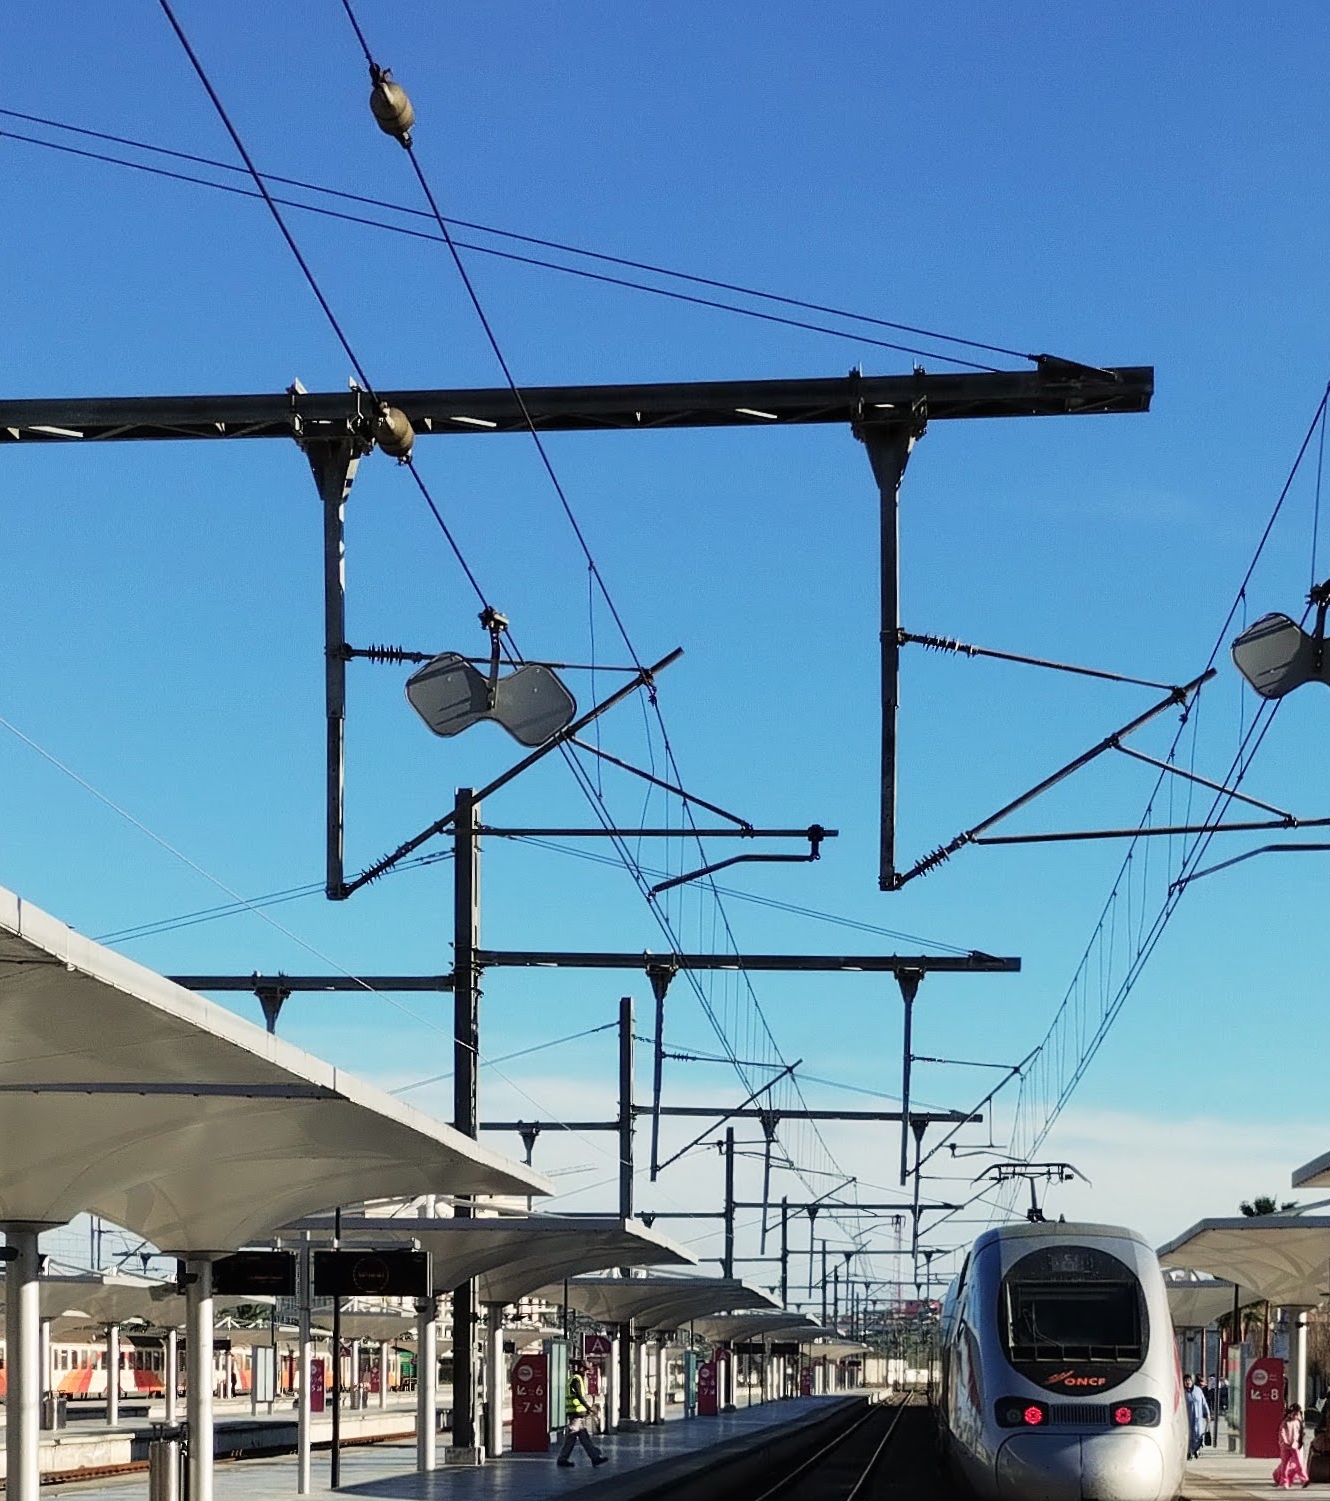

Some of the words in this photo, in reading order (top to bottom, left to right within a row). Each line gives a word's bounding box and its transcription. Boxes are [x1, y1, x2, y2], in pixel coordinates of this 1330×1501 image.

[591, 1338, 606, 1352] A
[1064, 1377, 1106, 1386] ONCF
[535, 1385, 543, 1396] 6
[1271, 1389, 1278, 1400] 8
[522, 1402, 531, 1413] 7
